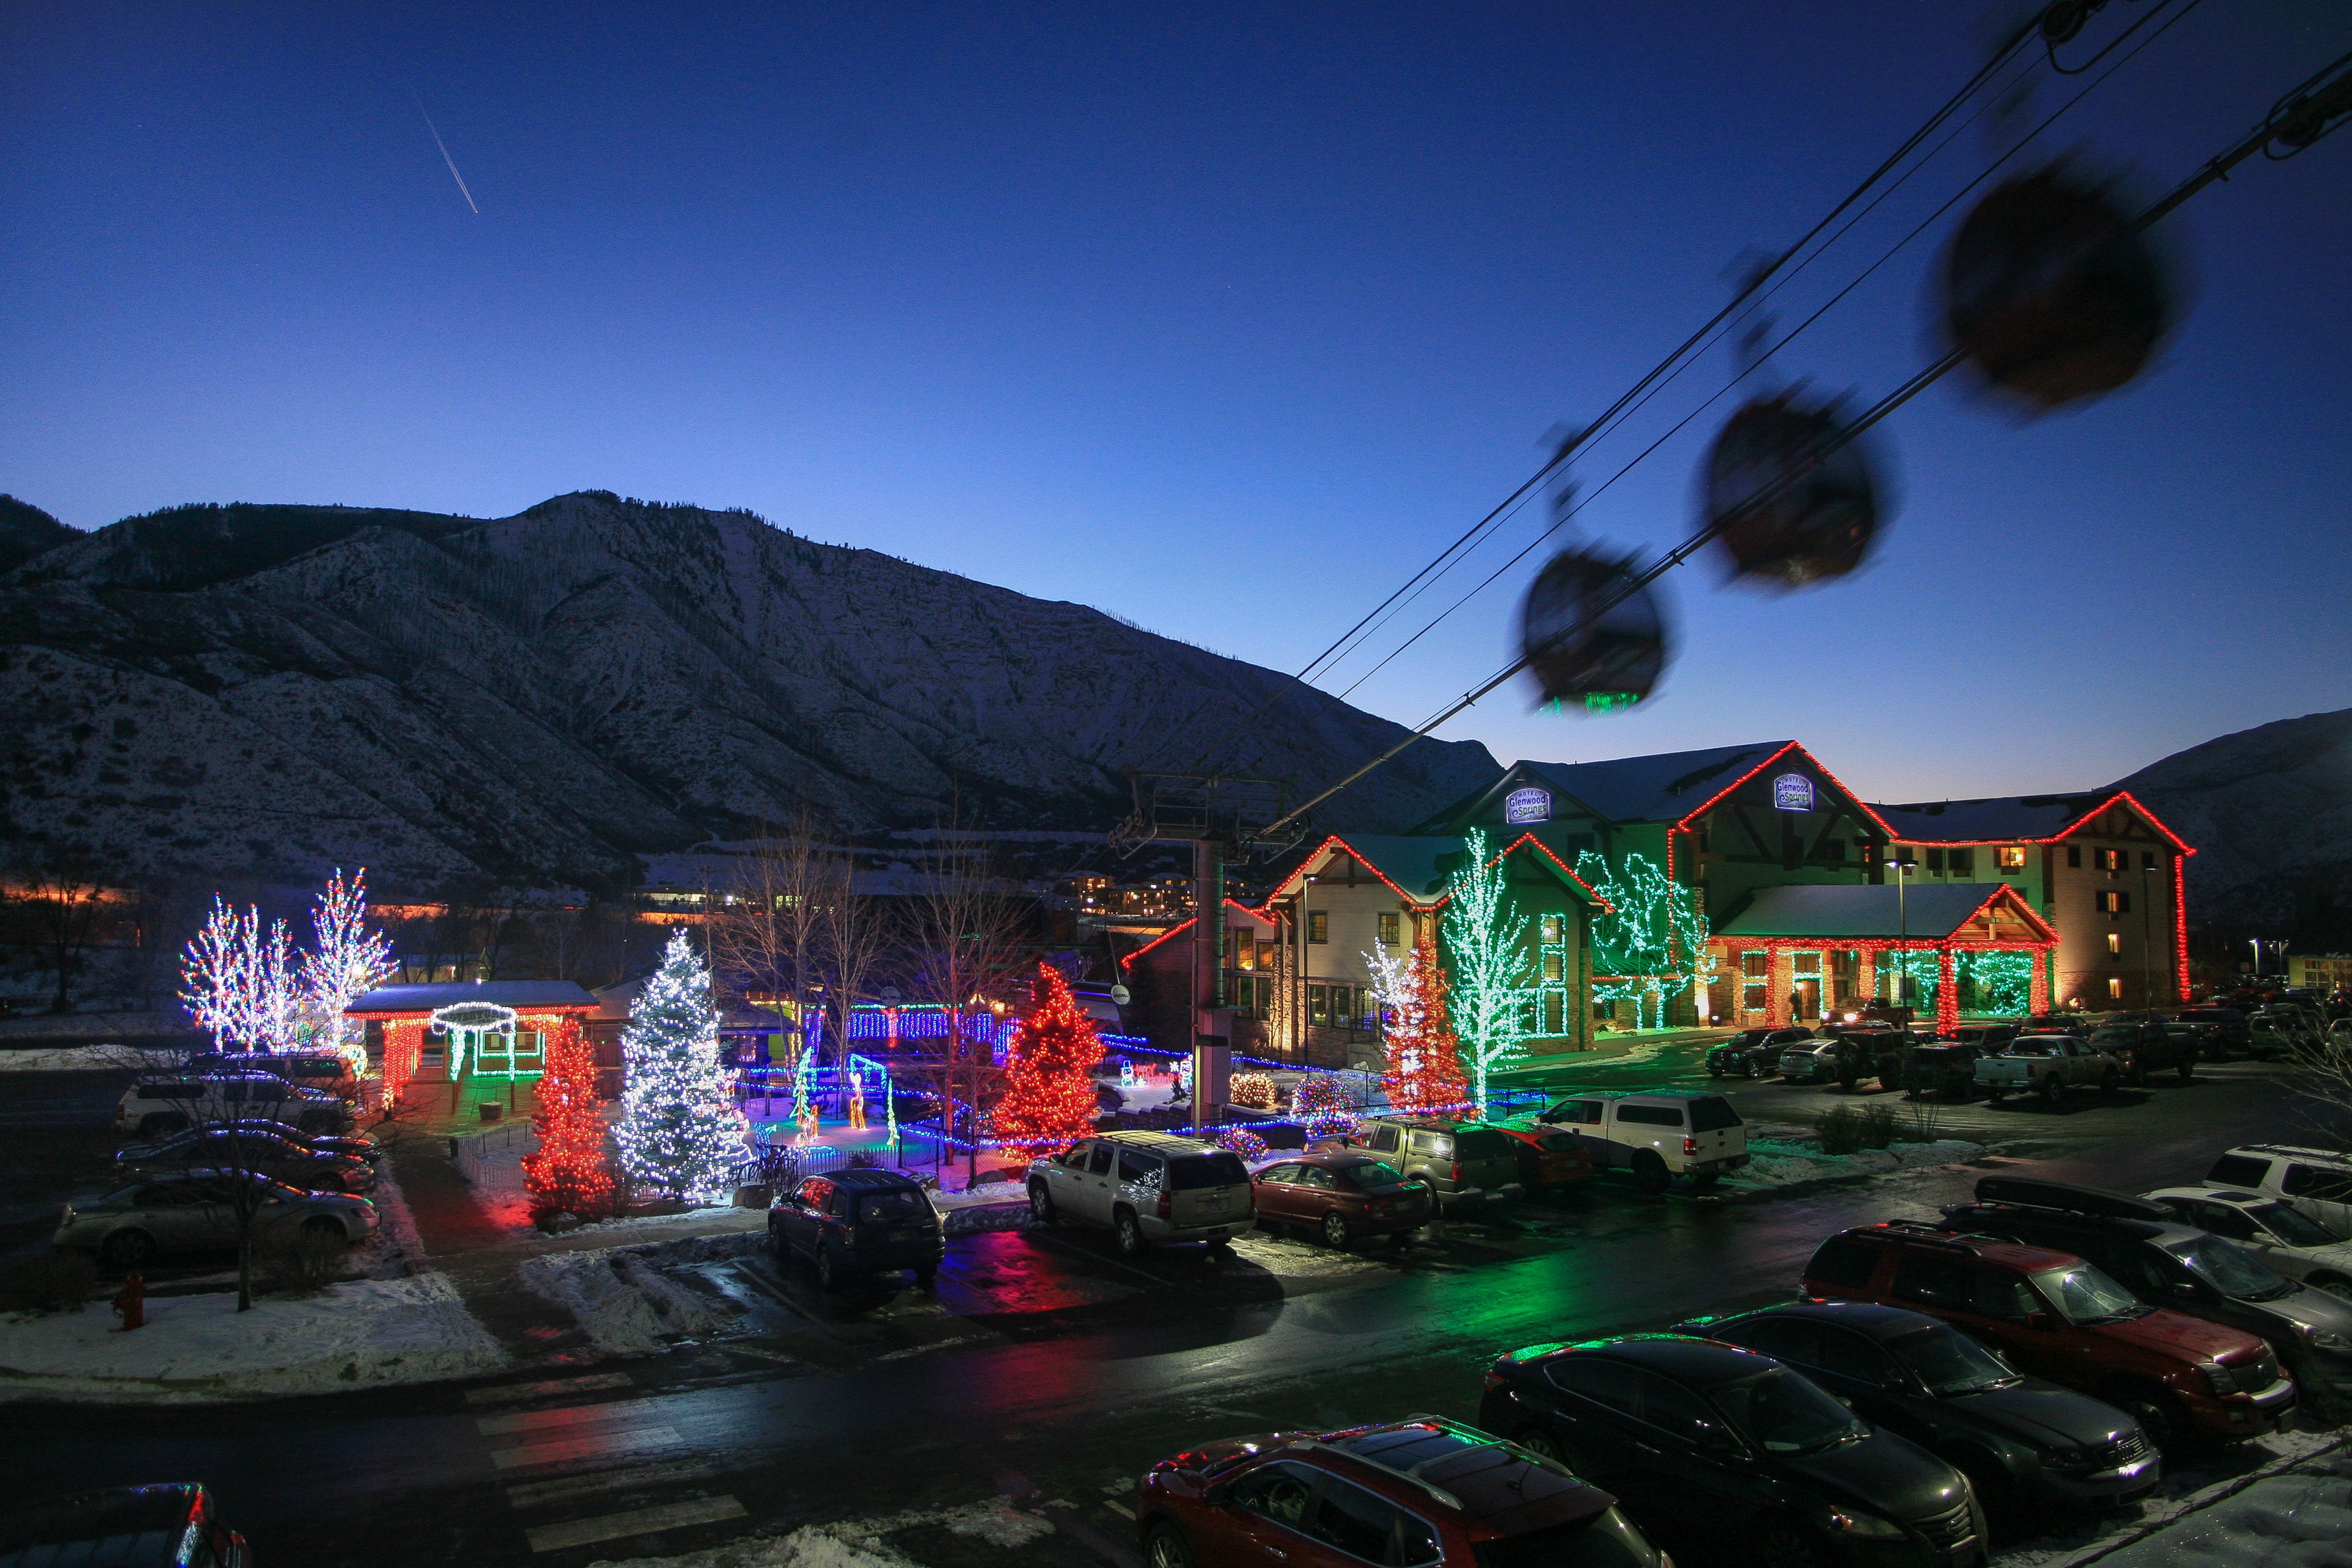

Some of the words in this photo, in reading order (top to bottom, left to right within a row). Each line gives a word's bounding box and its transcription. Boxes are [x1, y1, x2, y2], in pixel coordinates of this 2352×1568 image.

[1777, 782, 1808, 793] Glenwood
[1509, 794, 1545, 807] Glenwood
[1785, 792, 1809, 803] Springs
[1518, 805, 1547, 815] Springs
